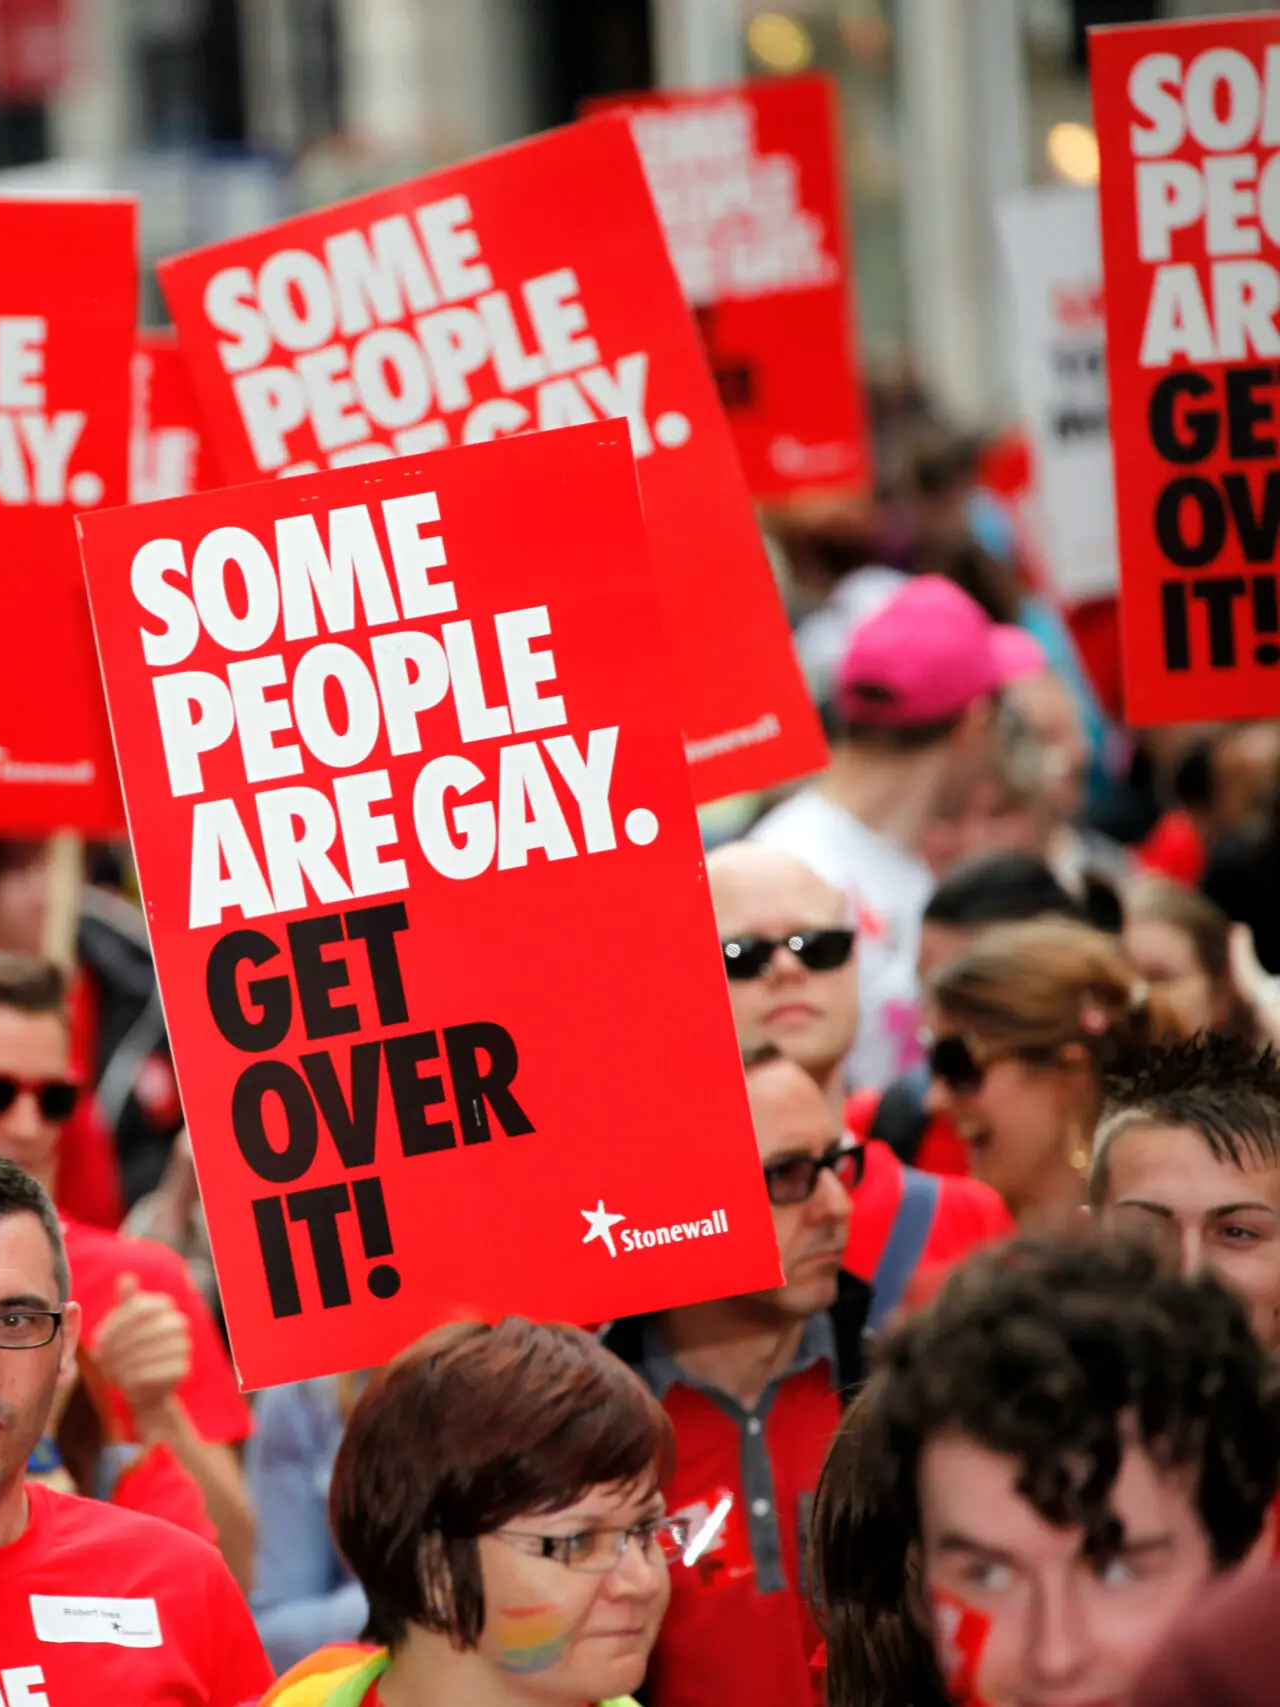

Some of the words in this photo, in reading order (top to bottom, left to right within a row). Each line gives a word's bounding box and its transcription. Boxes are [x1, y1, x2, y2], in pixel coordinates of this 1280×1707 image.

[204, 194, 493, 371] SOME
[1134, 153, 1280, 262] PE
[232, 267, 601, 471] PEOPLE
[129, 491, 459, 667] SOME
[1161, 573, 1280, 671] IT!
[152, 605, 568, 798] PEOPLE
[188, 768, 410, 930] ARE
[412, 725, 659, 881] GAY.
[205, 901, 409, 1053] GET
[232, 1021, 536, 1183] OVER
[252, 1176, 402, 1319] IT!
[619, 1208, 729, 1253] Stonewall
